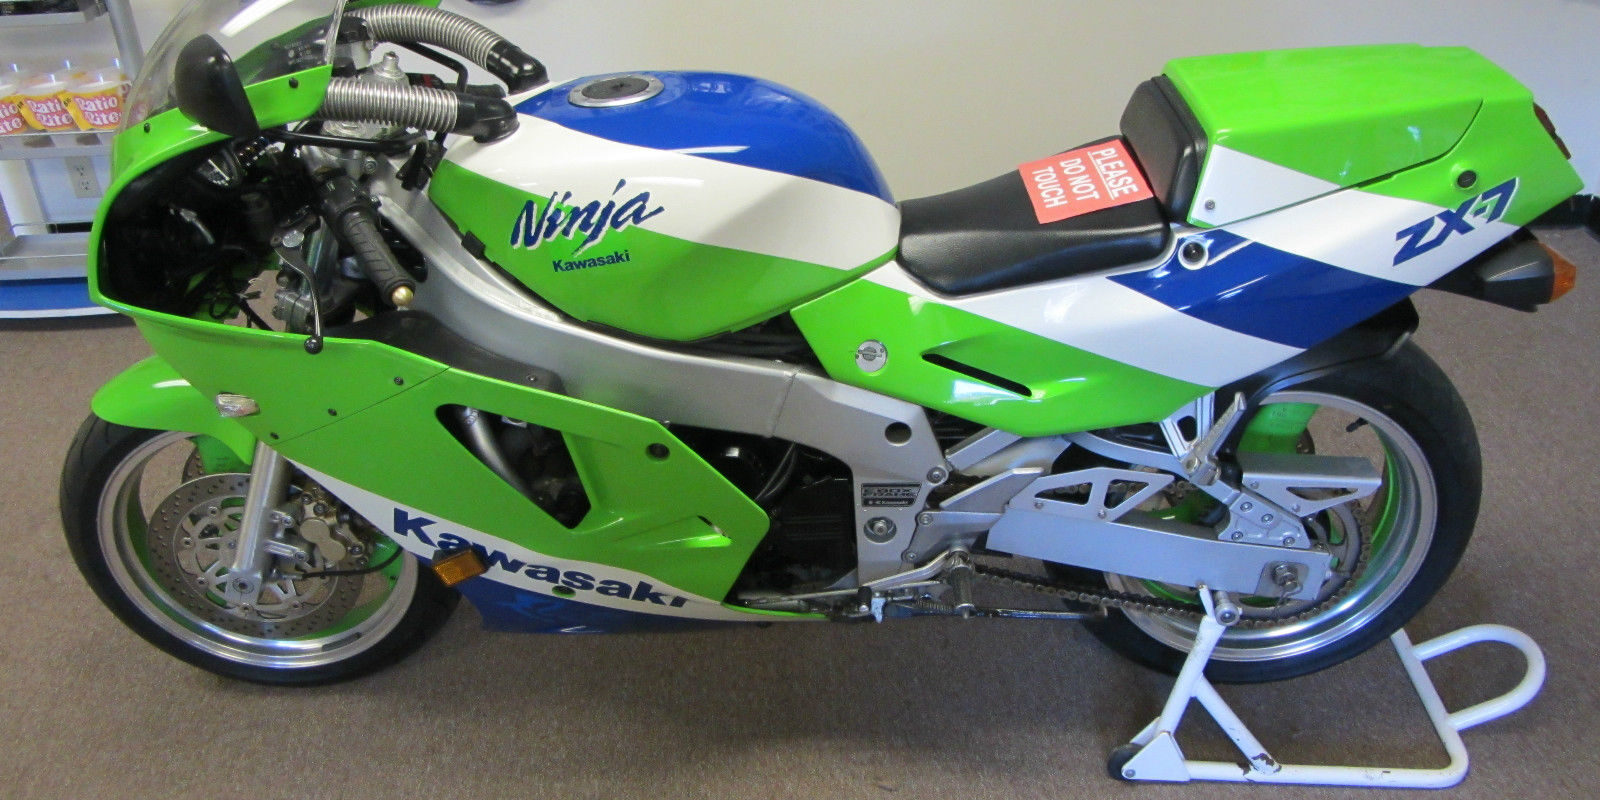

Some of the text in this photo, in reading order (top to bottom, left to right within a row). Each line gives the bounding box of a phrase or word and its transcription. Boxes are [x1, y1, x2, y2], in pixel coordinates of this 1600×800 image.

[27, 97, 62, 114] Rati
[36, 112, 73, 127] Rite
[75, 95, 118, 113] Ratio
[83, 111, 121, 126] Rite
[1031, 165, 1069, 209] TOUCH
[1059, 157, 1101, 202] DO NOT
[1091, 147, 1139, 198] PLEASE
[510, 178, 665, 258] Ninja
[1393, 176, 1519, 267] ZX-7
[552, 249, 632, 272] Kawasaki
